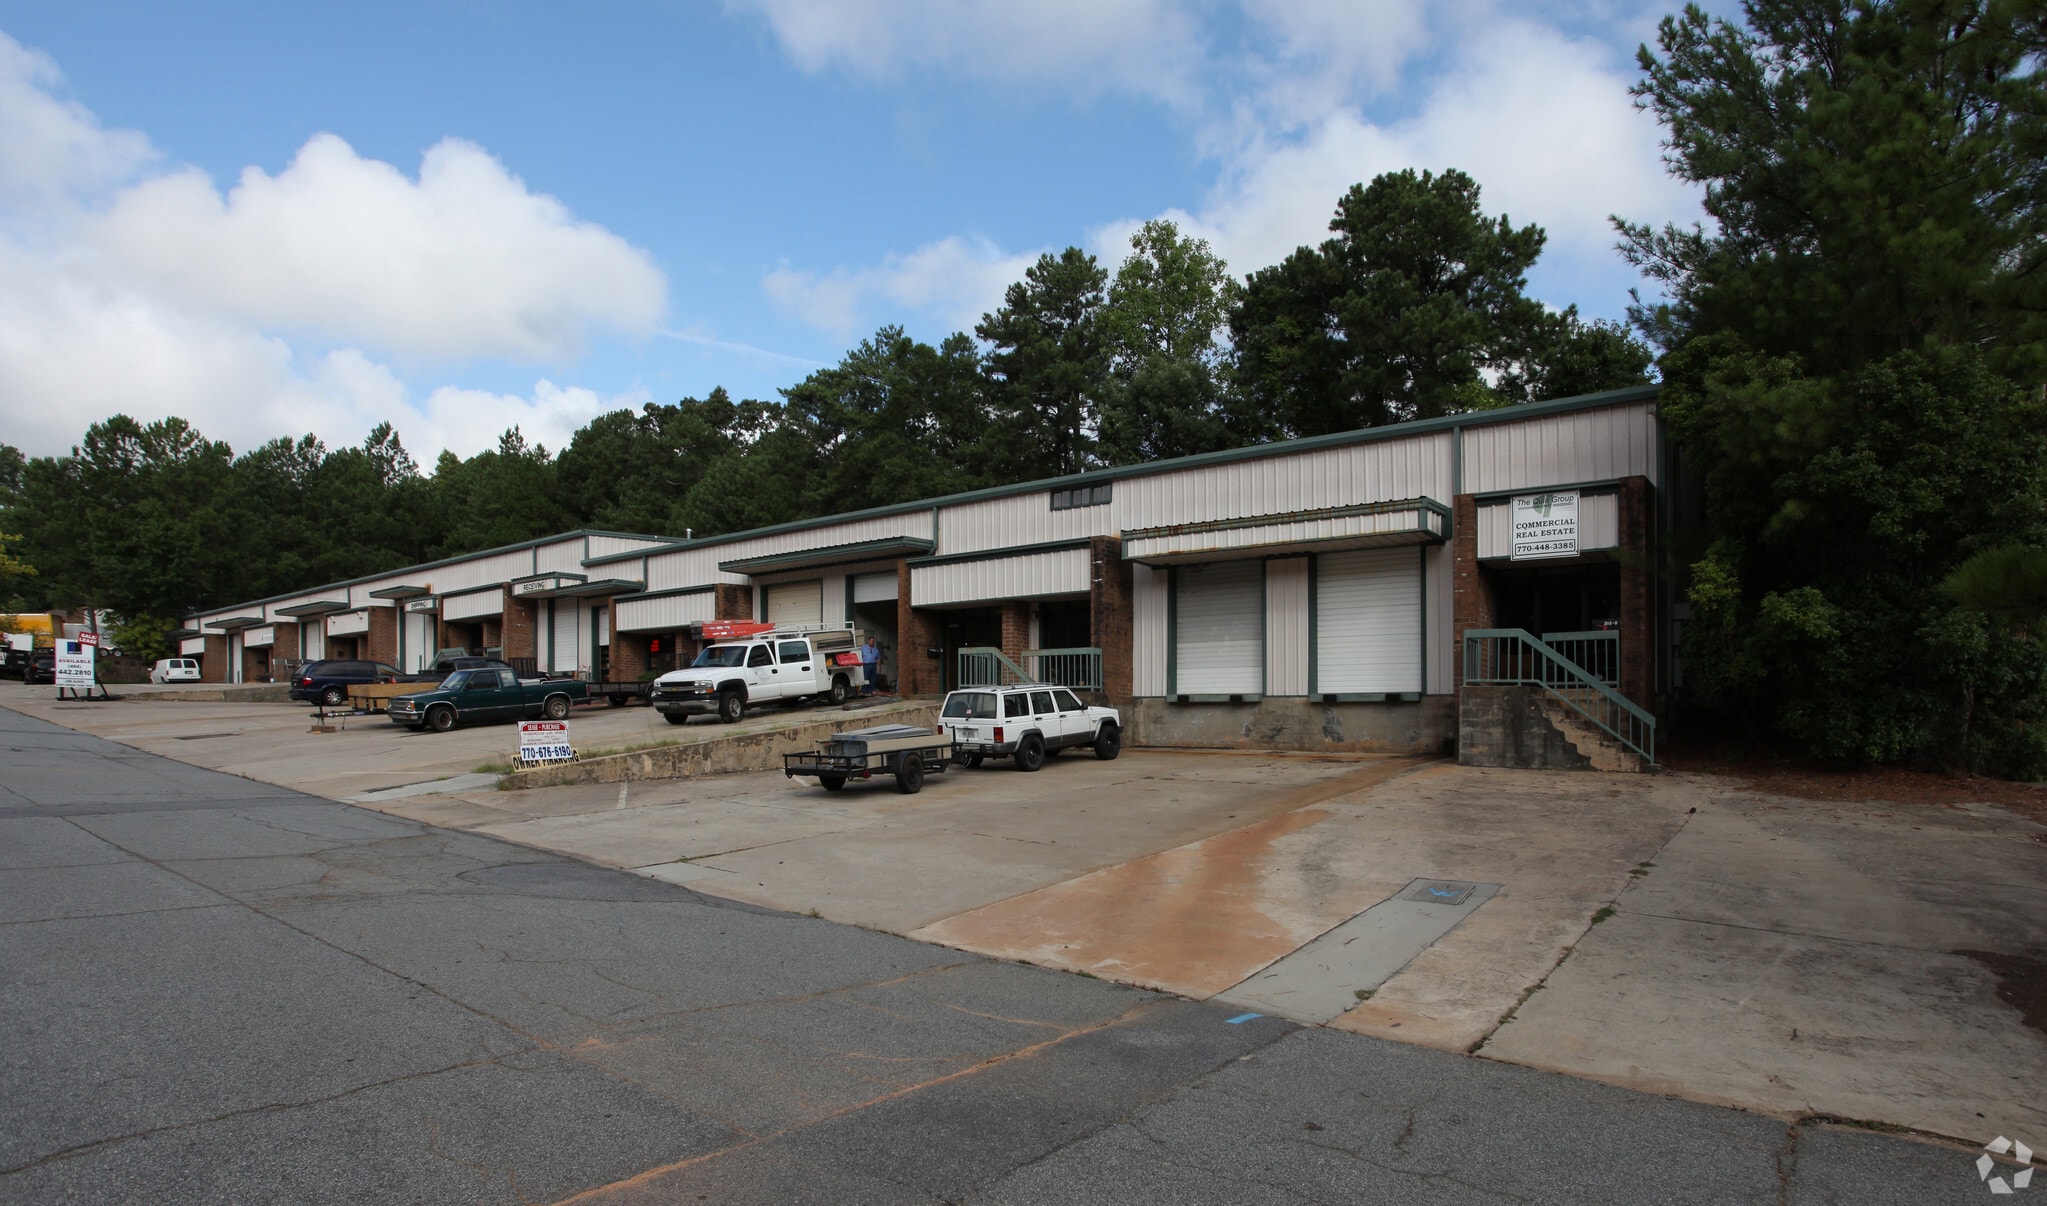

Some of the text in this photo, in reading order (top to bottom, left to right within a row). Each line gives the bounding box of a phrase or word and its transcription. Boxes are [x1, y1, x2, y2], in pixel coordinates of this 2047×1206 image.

[1552, 495, 1575, 503] Group
[1516, 518, 1575, 530] COMMERCIAL
[1516, 527, 1575, 539] REAL ESTATE
[1516, 541, 1574, 553] 770-448-3385
[521, 745, 572, 760] 770-676-6190
